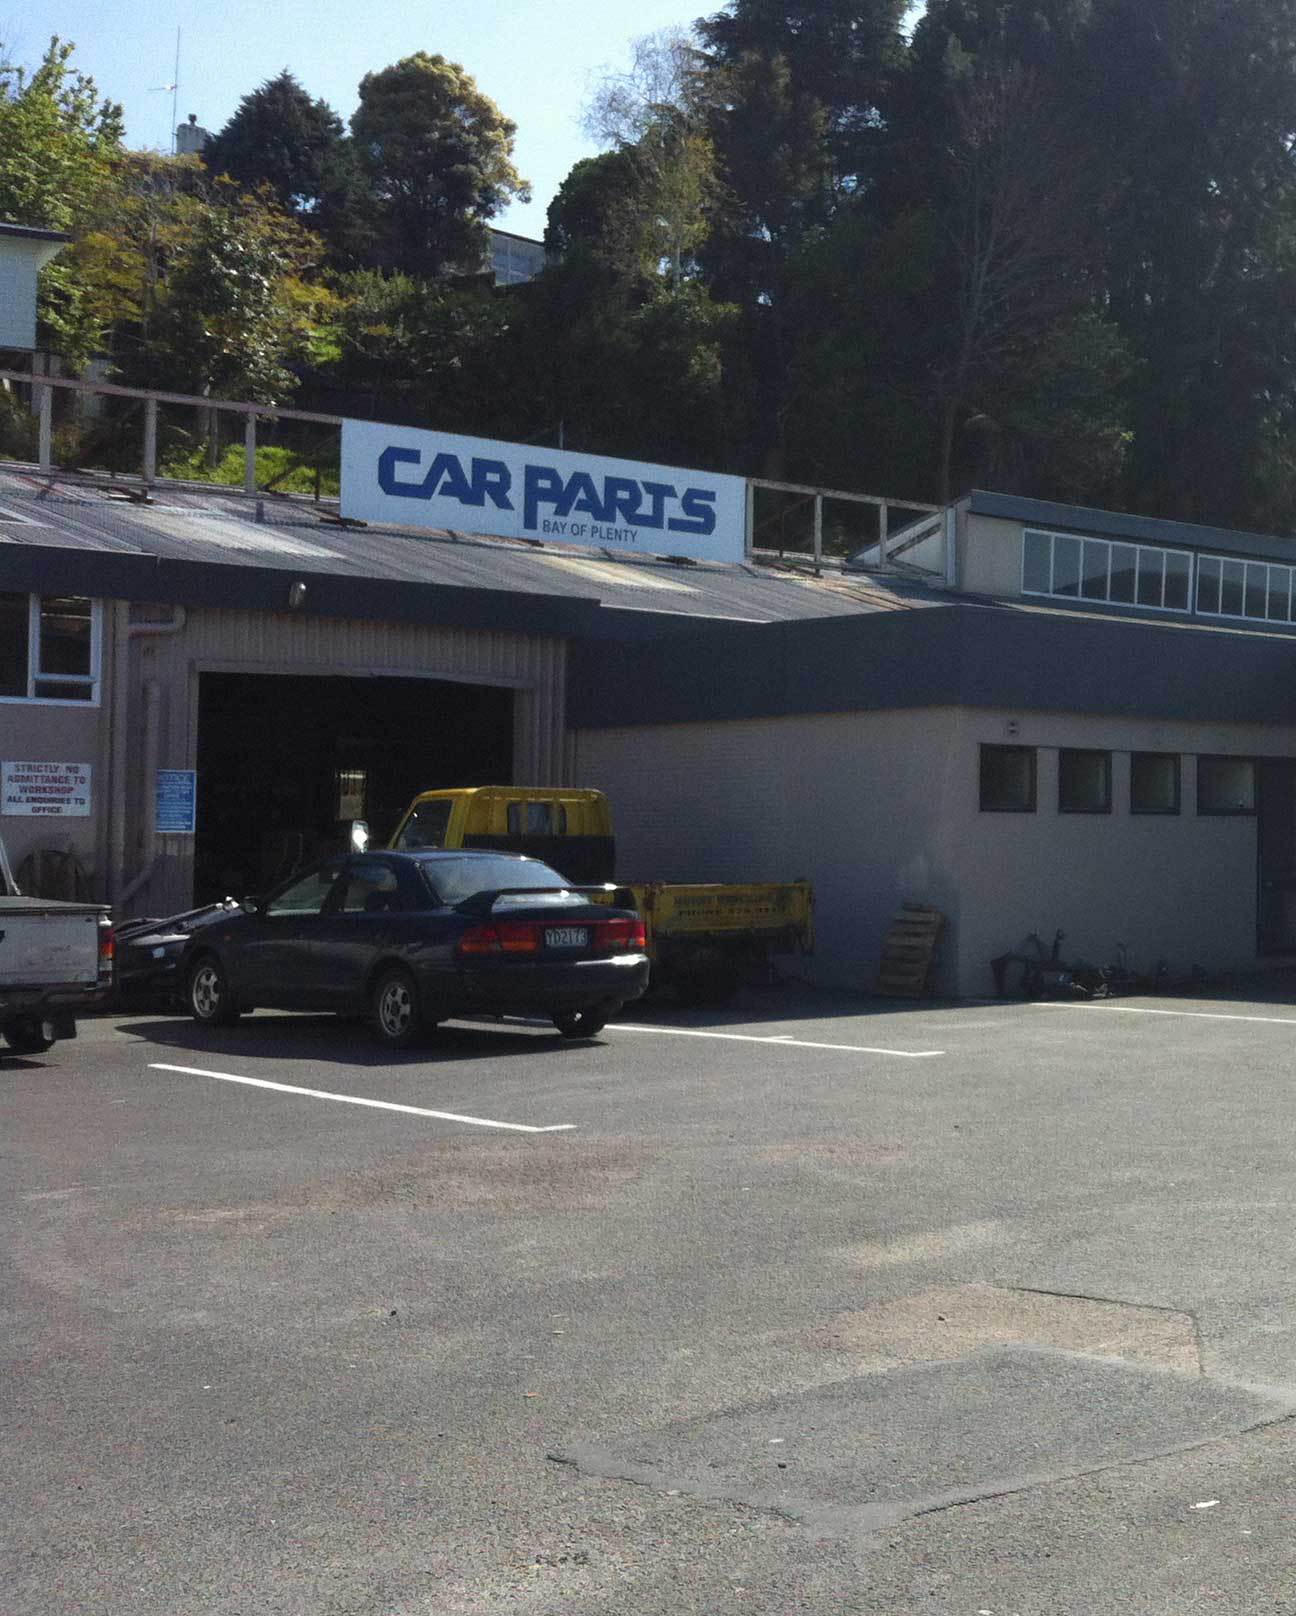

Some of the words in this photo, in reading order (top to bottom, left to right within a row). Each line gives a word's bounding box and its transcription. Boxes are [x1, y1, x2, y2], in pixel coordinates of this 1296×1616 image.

[378, 445, 514, 511] CAR
[523, 463, 717, 536] PARTS
[543, 519, 568, 535] BAY
[570, 523, 588, 537] OF
[591, 525, 638, 543] PLENTY
[15, 763, 60, 773] STRICTLY
[65, 765, 80, 774] NO
[7, 774, 71, 785] ADMITTANCE
[73, 775, 86, 785] TO
[18, 785, 75, 795] WORKSHOP
[7, 795, 25, 803] ALL
[73, 797, 86, 806] TO
[31, 806, 63, 814] OFFICE
